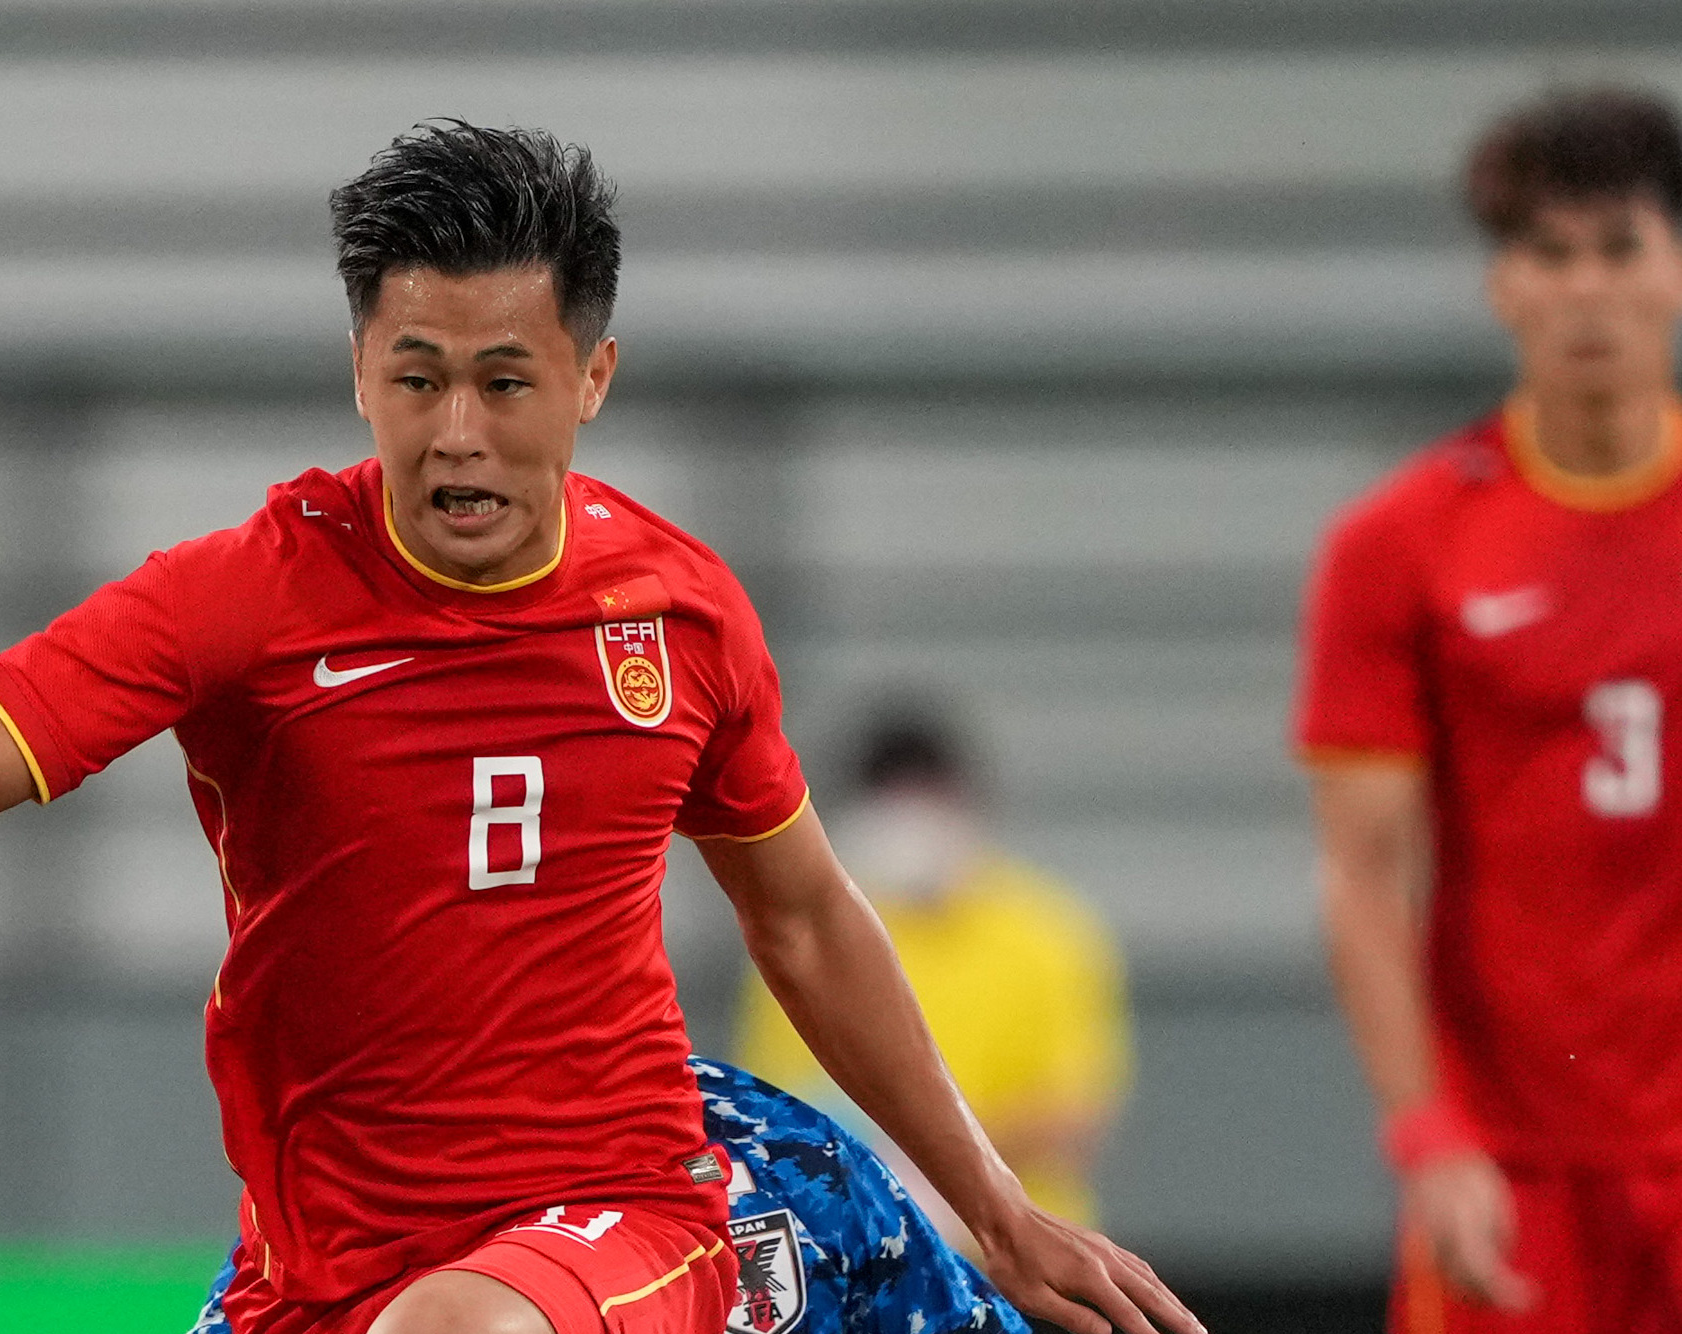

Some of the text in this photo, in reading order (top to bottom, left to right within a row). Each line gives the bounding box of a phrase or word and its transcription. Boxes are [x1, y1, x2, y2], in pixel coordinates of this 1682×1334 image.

[604, 622, 656, 641] CFA
[1583, 680, 1662, 816] 3
[468, 755, 545, 891] 8
[728, 1220, 767, 1236] APAN
